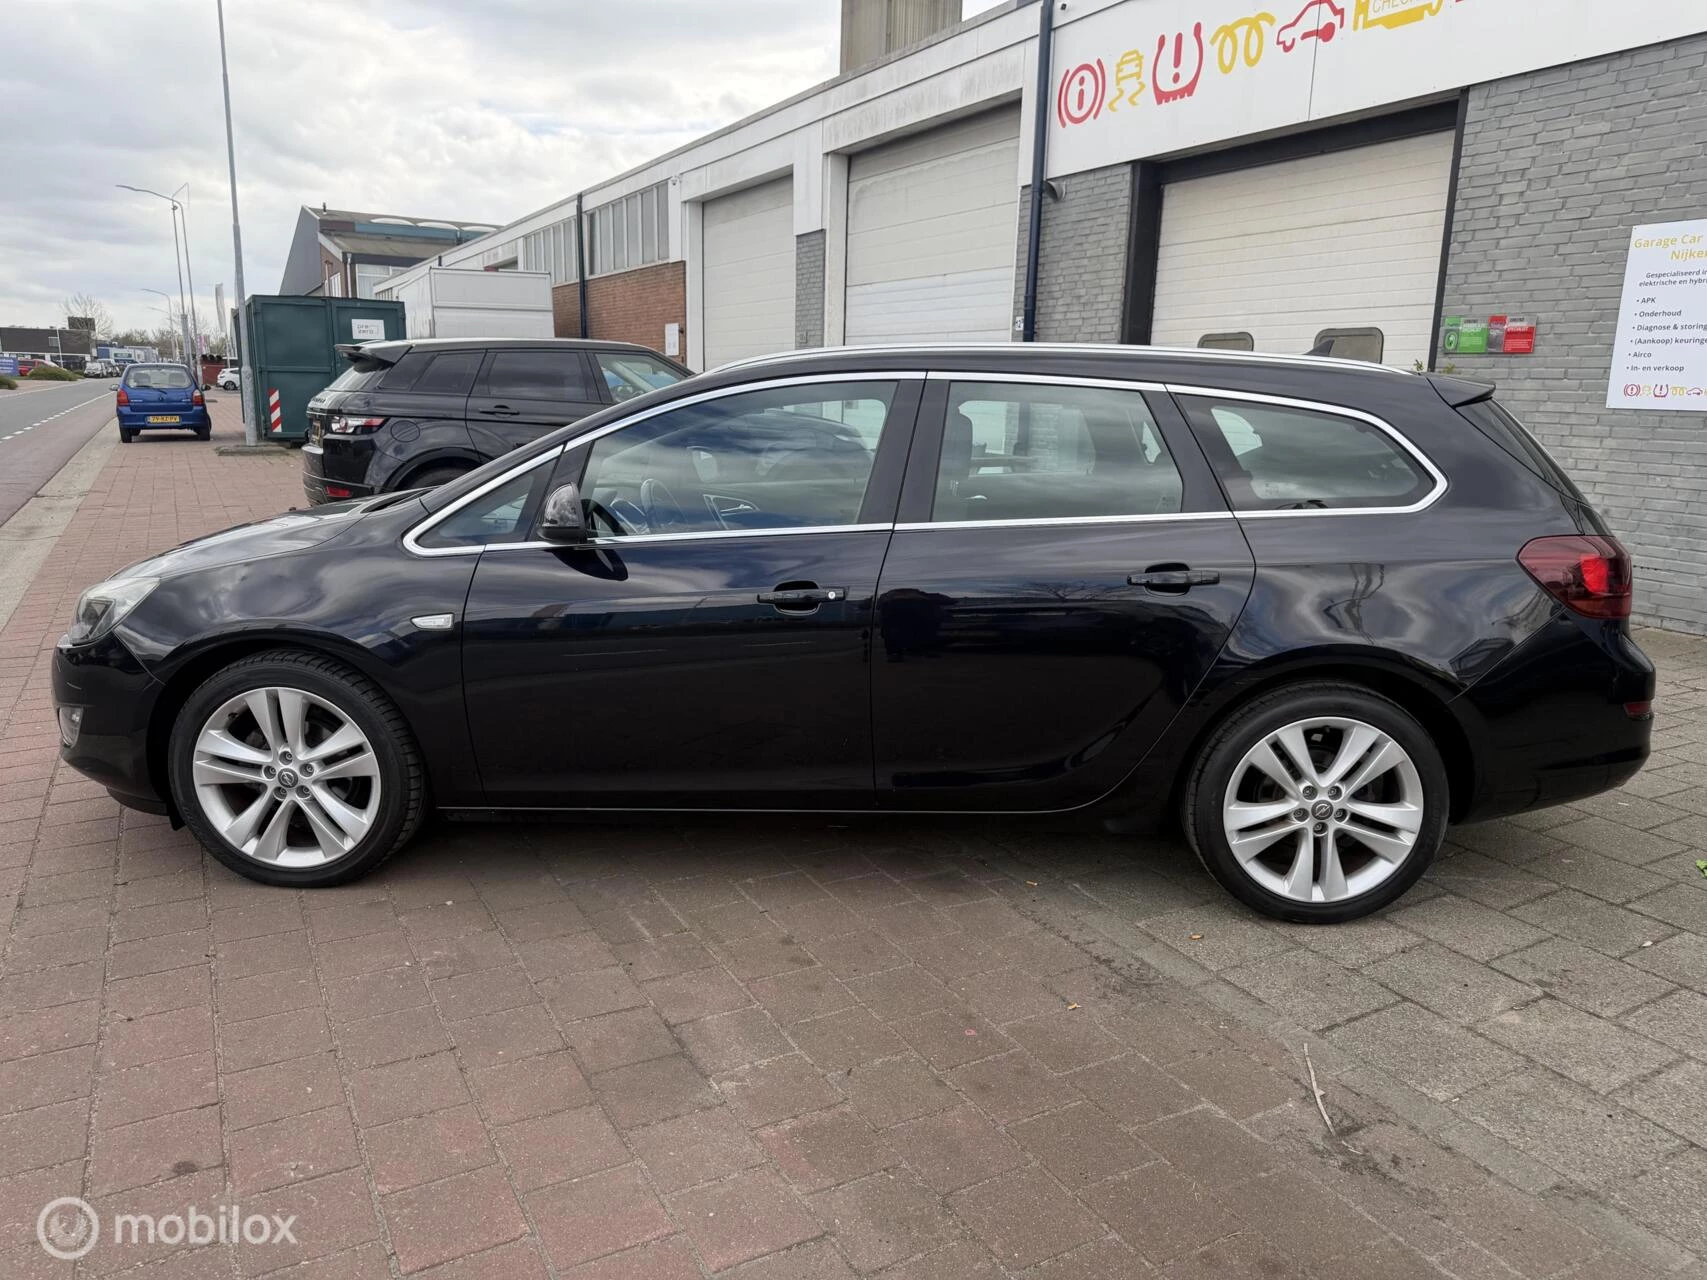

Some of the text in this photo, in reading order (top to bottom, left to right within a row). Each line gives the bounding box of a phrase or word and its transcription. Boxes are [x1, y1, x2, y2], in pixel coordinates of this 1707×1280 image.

[1634, 234, 1704, 249] Garage Car
[1646, 269, 1701, 279] Gespecialiseerd
[1639, 279, 1677, 287] elektrische
[1639, 310, 1682, 318] Onderhoud
[1637, 324, 1671, 332] Diagnose
[1634, 338, 1673, 346] (Aankoop)
[1653, 365, 1685, 373] verkoop
